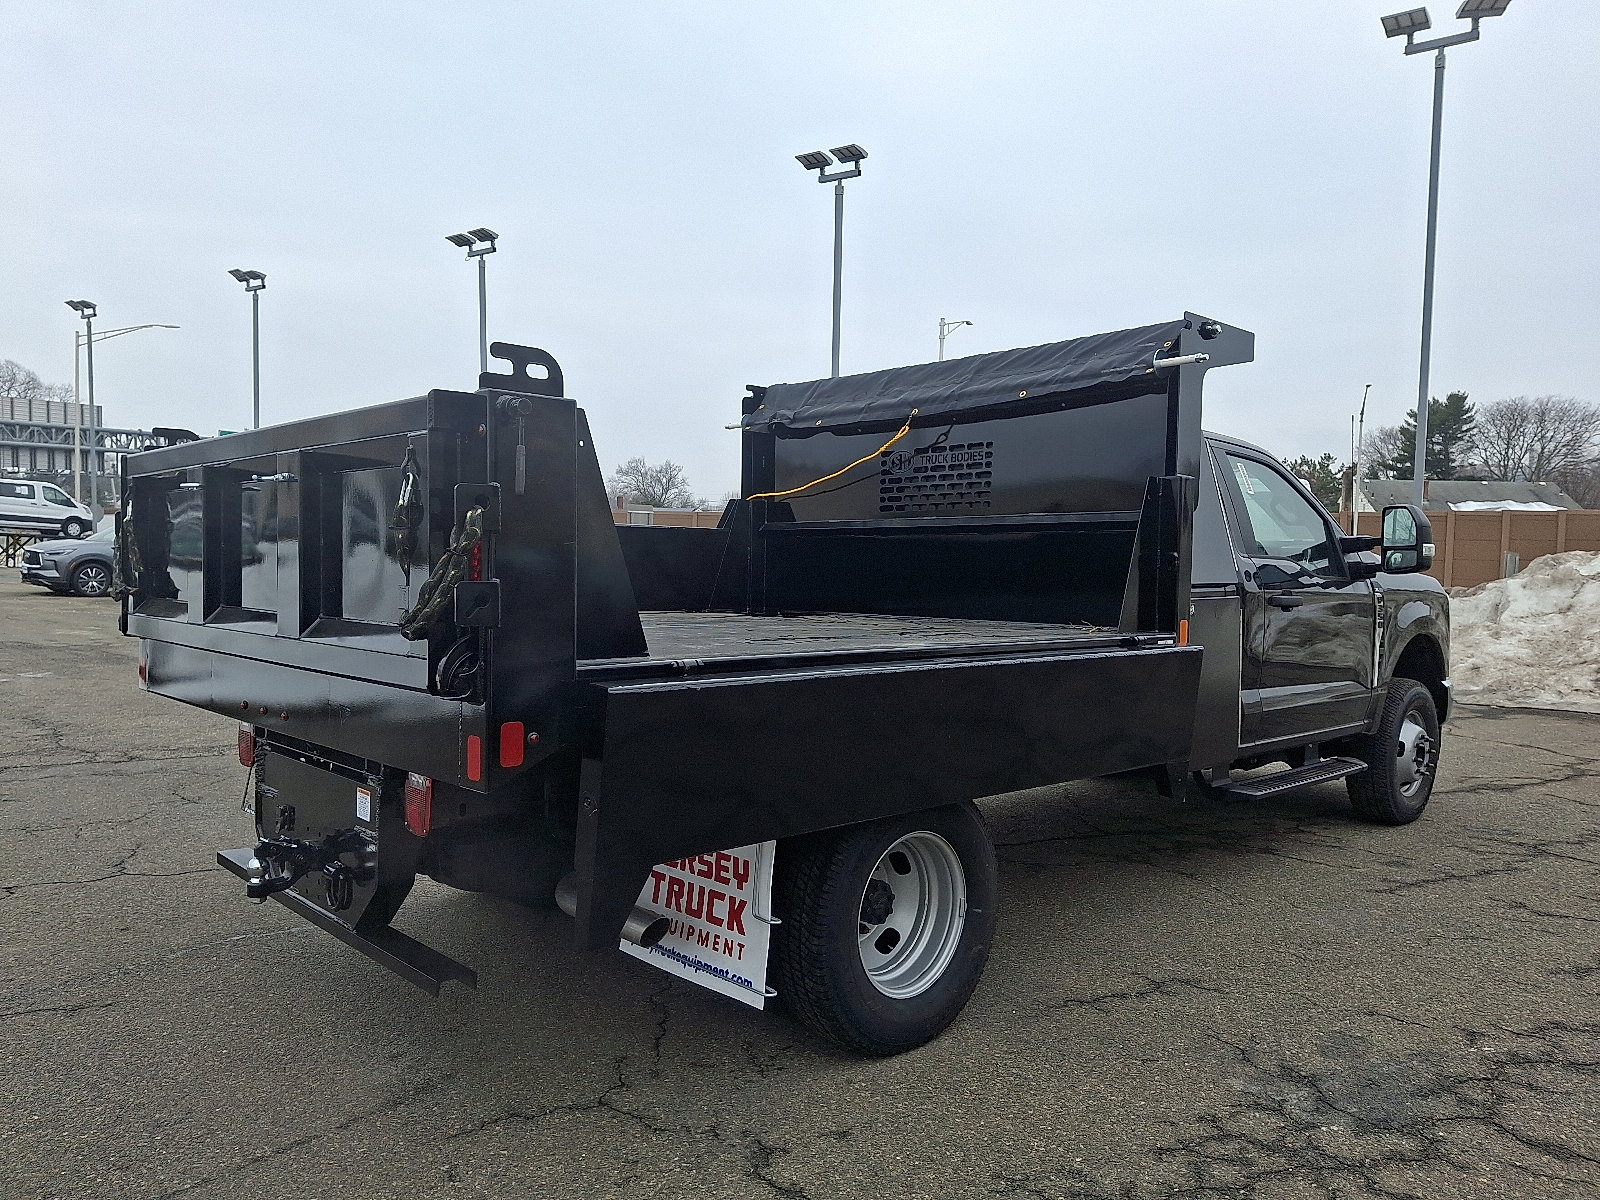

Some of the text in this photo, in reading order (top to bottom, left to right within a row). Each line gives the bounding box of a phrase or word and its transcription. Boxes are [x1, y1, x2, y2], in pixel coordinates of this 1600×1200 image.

[920, 451, 984, 466] TRUCK BODIES
[651, 869, 748, 936] TRUCK
[668, 917, 746, 960] UIPMENT
